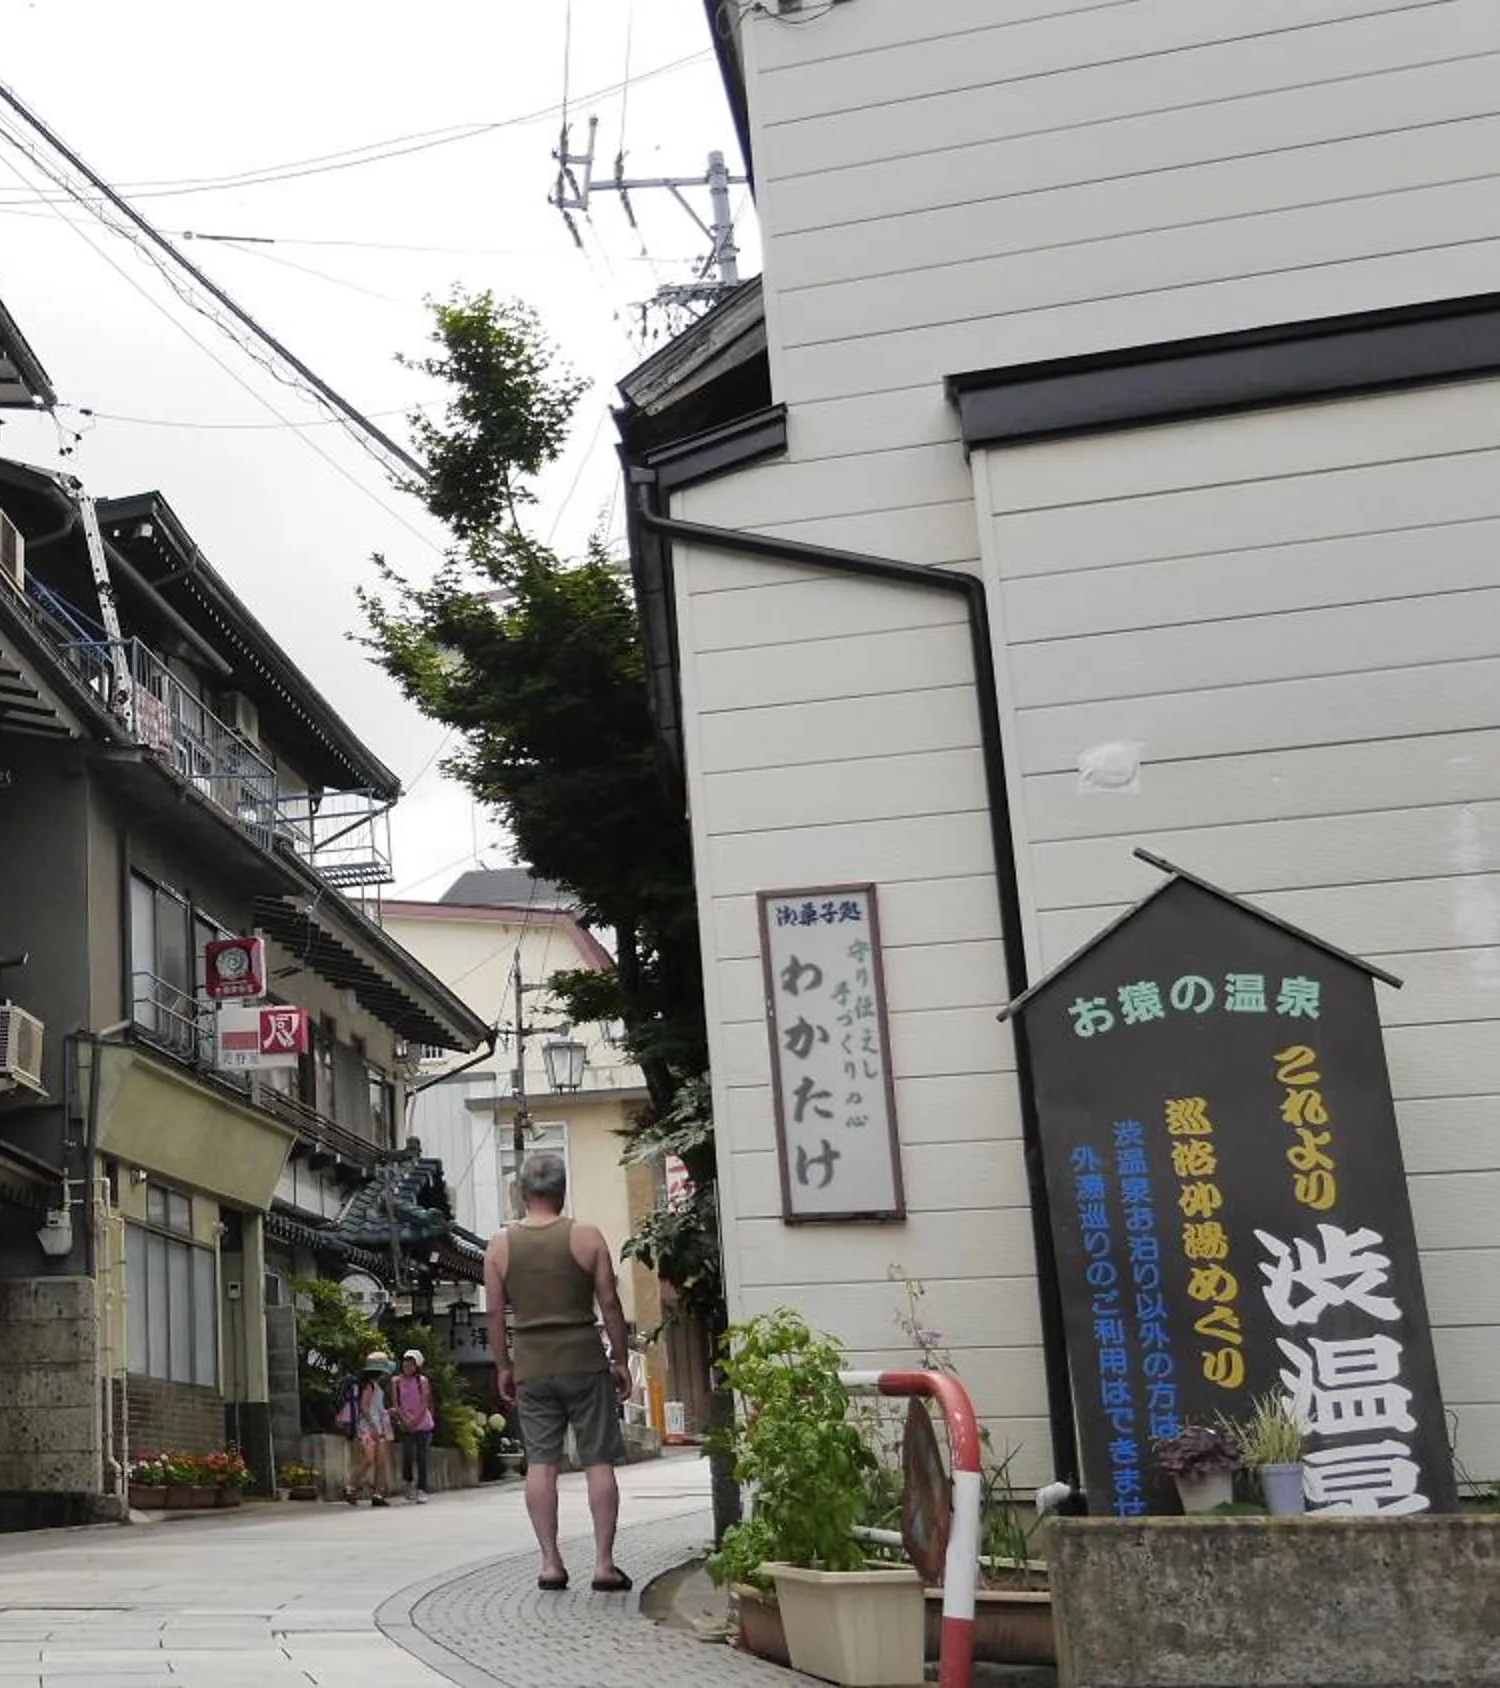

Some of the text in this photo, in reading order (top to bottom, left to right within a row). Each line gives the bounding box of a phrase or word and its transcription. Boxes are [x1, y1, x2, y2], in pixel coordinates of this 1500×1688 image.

[775, 901, 862, 926] 御菓子処
[781, 954, 840, 1189] わかたけ
[1068, 973, 1321, 1037] お猿の温泉
[1273, 1045, 1336, 1210] これより
[1112, 1119, 1185, 1440] 渋温泉お泊り以外の方は
